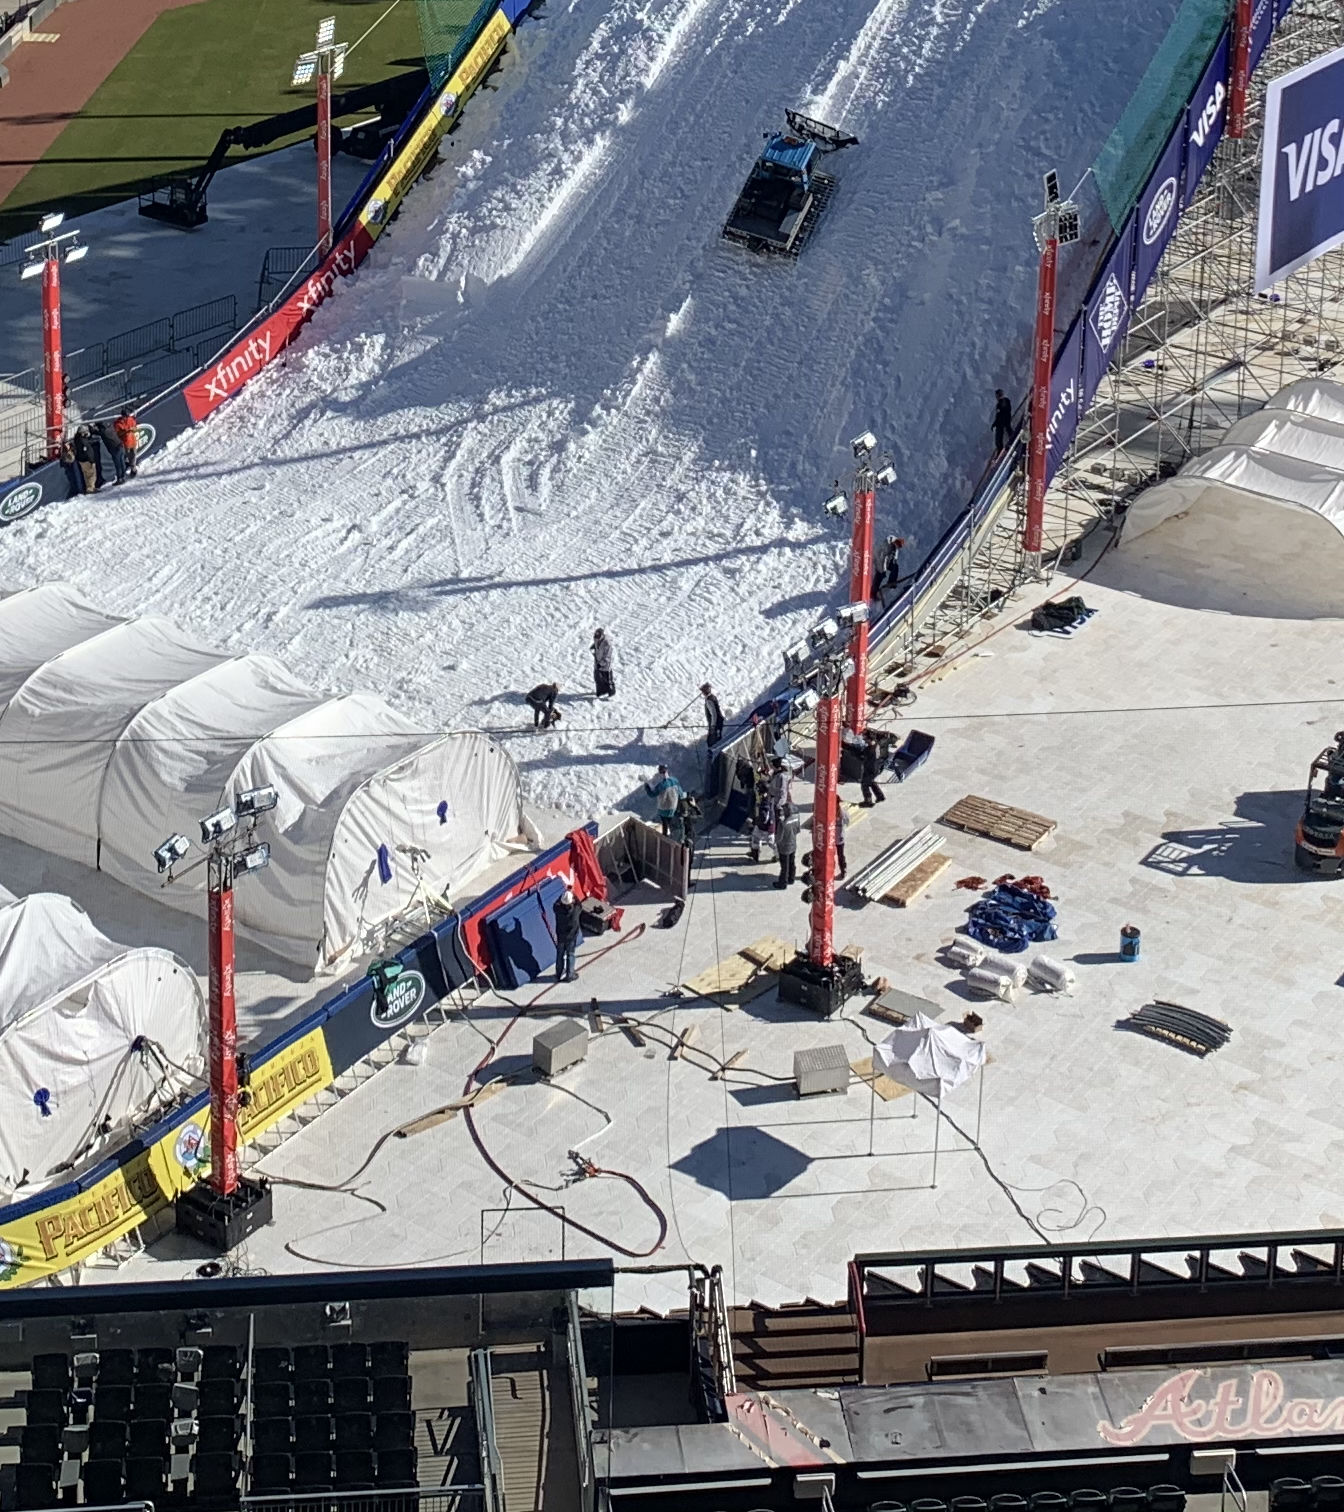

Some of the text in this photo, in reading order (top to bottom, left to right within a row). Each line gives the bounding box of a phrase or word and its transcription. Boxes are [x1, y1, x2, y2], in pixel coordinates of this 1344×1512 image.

[1189, 81, 1226, 148] VISA
[297, 240, 356, 317] xfinity
[204, 330, 271, 401] xfinity
[6, 495, 36, 515] ROVER
[7, 489, 30, 507] LAND
[820, 704, 830, 736] xfinity
[816, 763, 826, 793] xfinity
[816, 823, 824, 852] xfinity
[387, 981, 408, 1004] AND
[387, 989, 416, 1019] ROVER
[241, 1048, 320, 1127] ACIFICO
[35, 1168, 159, 1262] PACIFICO
